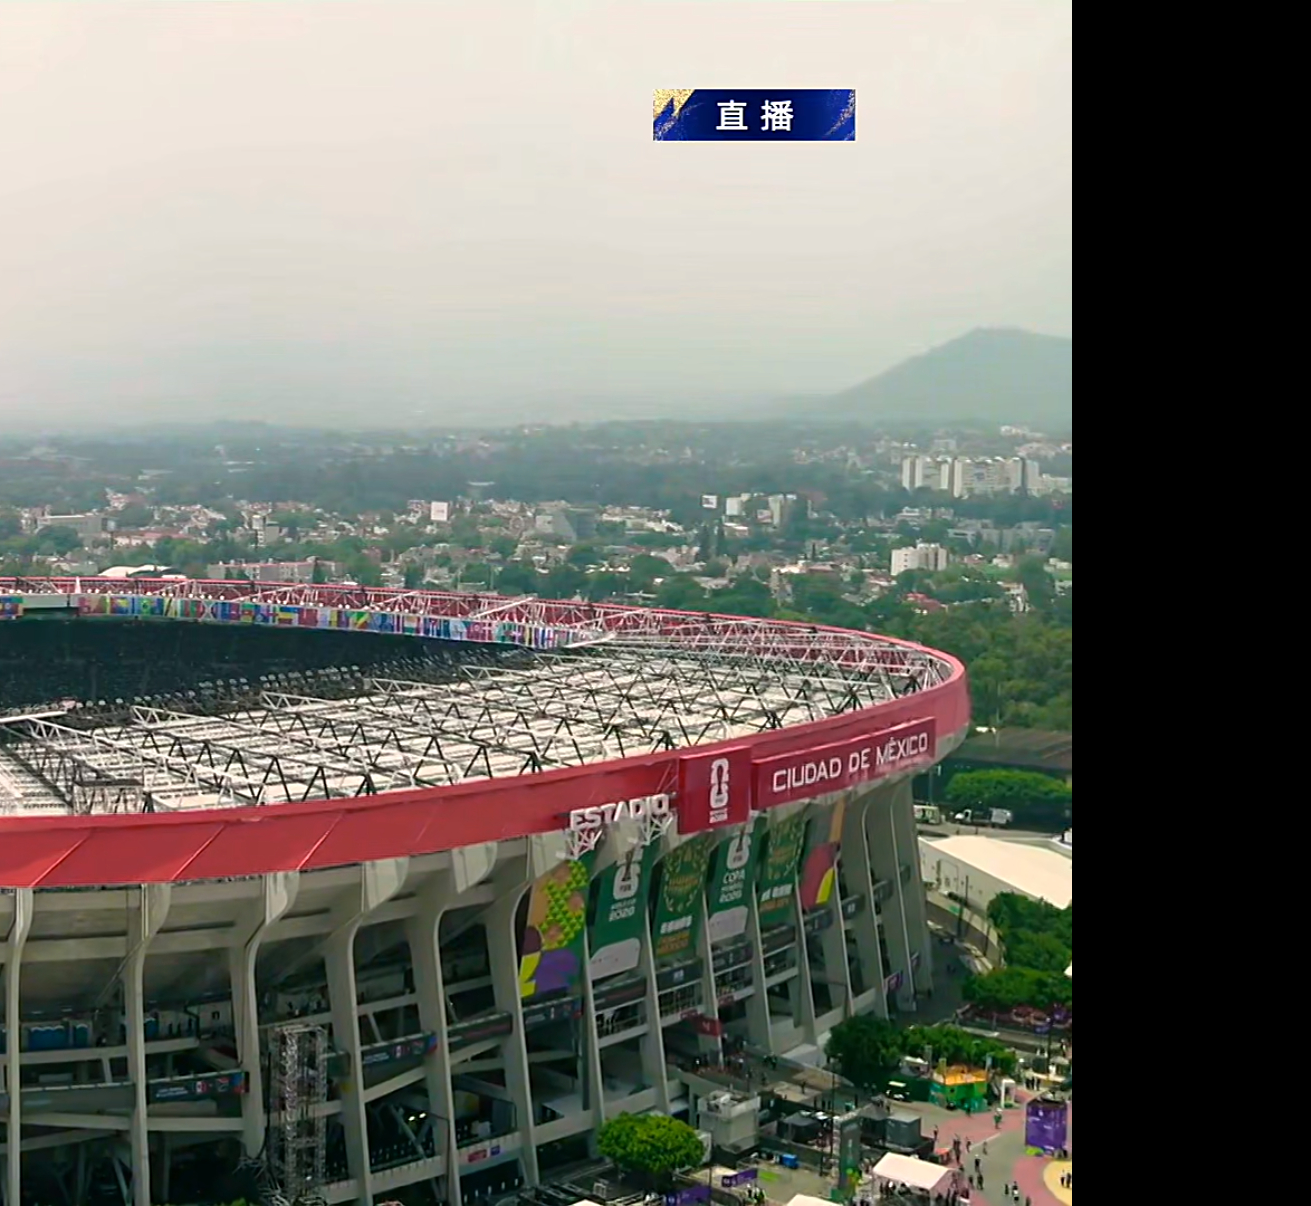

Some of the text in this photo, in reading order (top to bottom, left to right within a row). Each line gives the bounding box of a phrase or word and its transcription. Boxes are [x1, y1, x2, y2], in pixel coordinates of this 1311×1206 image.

[772, 756, 842, 793] CIUDAD
[848, 747, 871, 773] DE
[570, 793, 670, 831] ESTADIO
